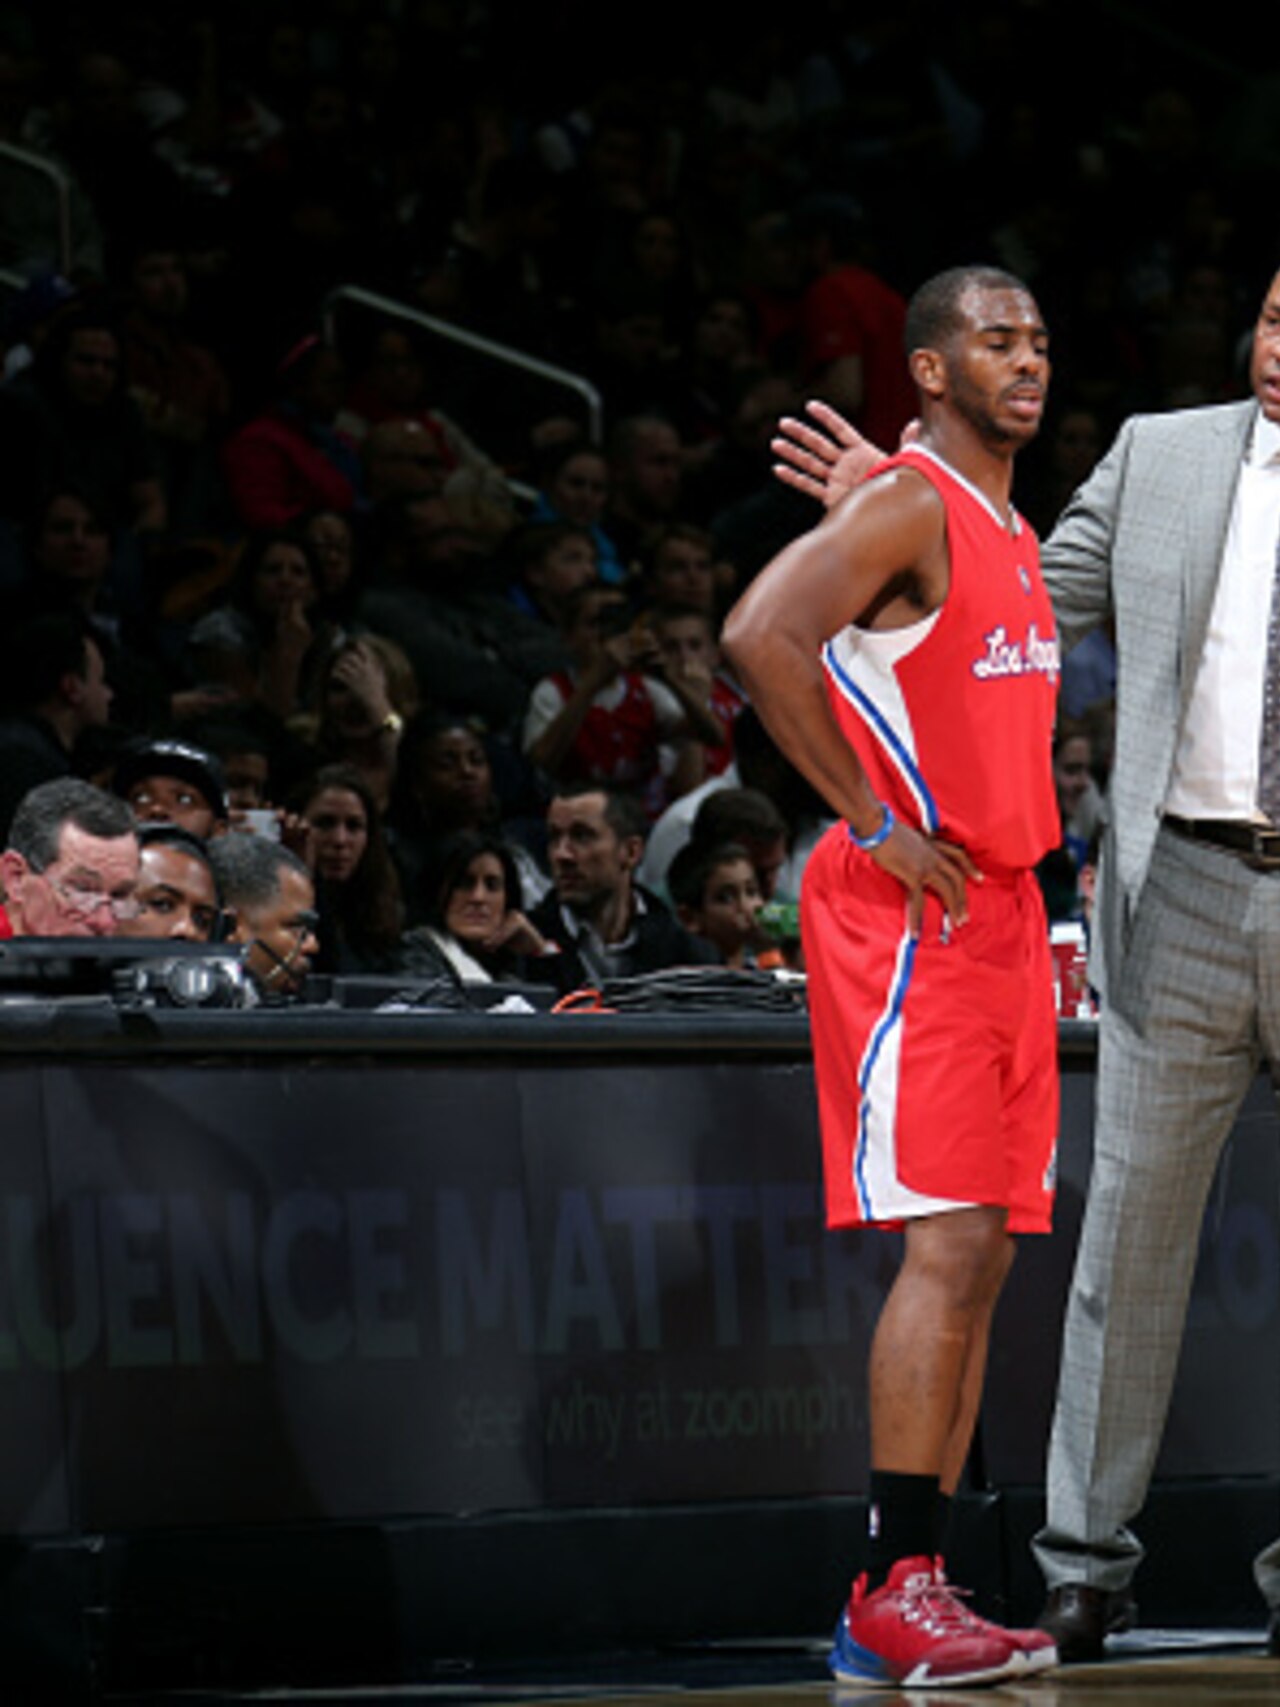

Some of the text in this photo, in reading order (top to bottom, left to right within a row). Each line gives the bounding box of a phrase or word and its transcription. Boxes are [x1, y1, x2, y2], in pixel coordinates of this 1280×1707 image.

[971, 624, 1022, 681] Los
[452, 1393, 523, 1450] see
[546, 1379, 627, 1460] why
[636, 1380, 672, 1442] at
